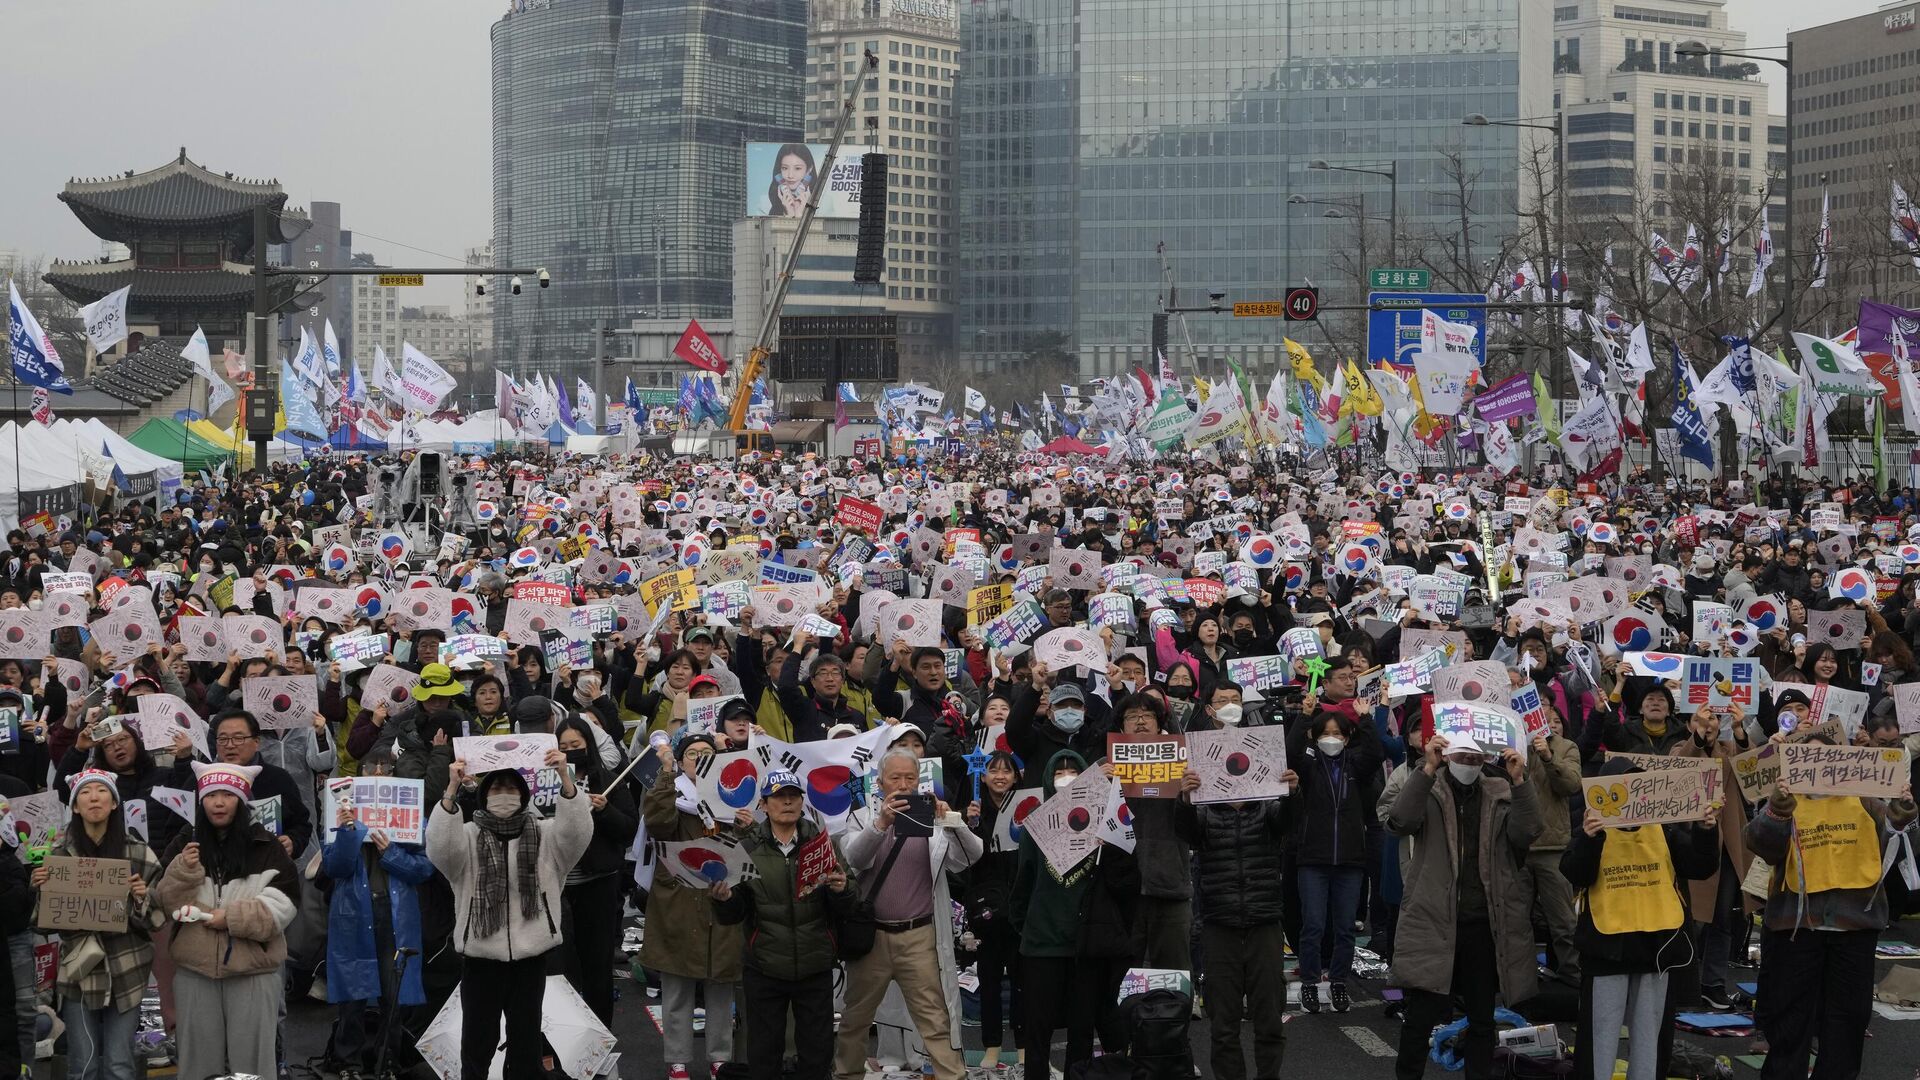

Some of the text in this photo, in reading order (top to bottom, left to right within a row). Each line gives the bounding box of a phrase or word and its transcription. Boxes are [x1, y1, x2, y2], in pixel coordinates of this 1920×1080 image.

[831, 164, 864, 181] 상쾌
[831, 181, 864, 191] BOOST
[847, 192, 863, 203] ZE
[1378, 272, 1420, 285] 광화문
[1234, 303, 1281, 315] 과속단속장비
[1293, 297, 1310, 312] 40
[689, 335, 719, 368] 진보당
[762, 564, 813, 584] 국민의힘
[46, 579, 92, 593] 윤석열 파면
[650, 573, 680, 594] 윤석열
[518, 587, 567, 599] 윤석열 파면
[976, 585, 1001, 605] 윤석열
[1437, 589, 1458, 602] 해체
[589, 607, 612, 619] 즉각
[1103, 598, 1128, 612] 해체
[1435, 603, 1457, 616] 하라
[1008, 602, 1034, 629] 즉각
[1104, 611, 1129, 626] 하라
[589, 618, 613, 633] 파면
[1016, 615, 1043, 644] 파면
[359, 646, 383, 662] 파면
[1291, 642, 1318, 657] 파면
[1255, 658, 1282, 675] 즉각
[1415, 653, 1441, 669] 즉각
[1257, 674, 1284, 690] 파면
[1441, 713, 1470, 721] 내란수괴
[1441, 718, 1470, 729] 윤석열
[1473, 711, 1508, 729] 즉각
[1473, 728, 1508, 745] 파면
[1114, 743, 1176, 761] 탄핵인용
[1785, 745, 1880, 765] 일본군성노예제
[769, 773, 800, 785] 이재명
[1113, 762, 1188, 784] 민생회복
[1786, 767, 1816, 787] 문제
[1629, 775, 1674, 798] 우리가
[350, 785, 419, 806] 민의힘
[1621, 796, 1704, 819] 기억하겠습니다
[47, 865, 71, 881] 우리는
[96, 867, 127, 885] 이 만든
[48, 895, 112, 924] 말벌시민
